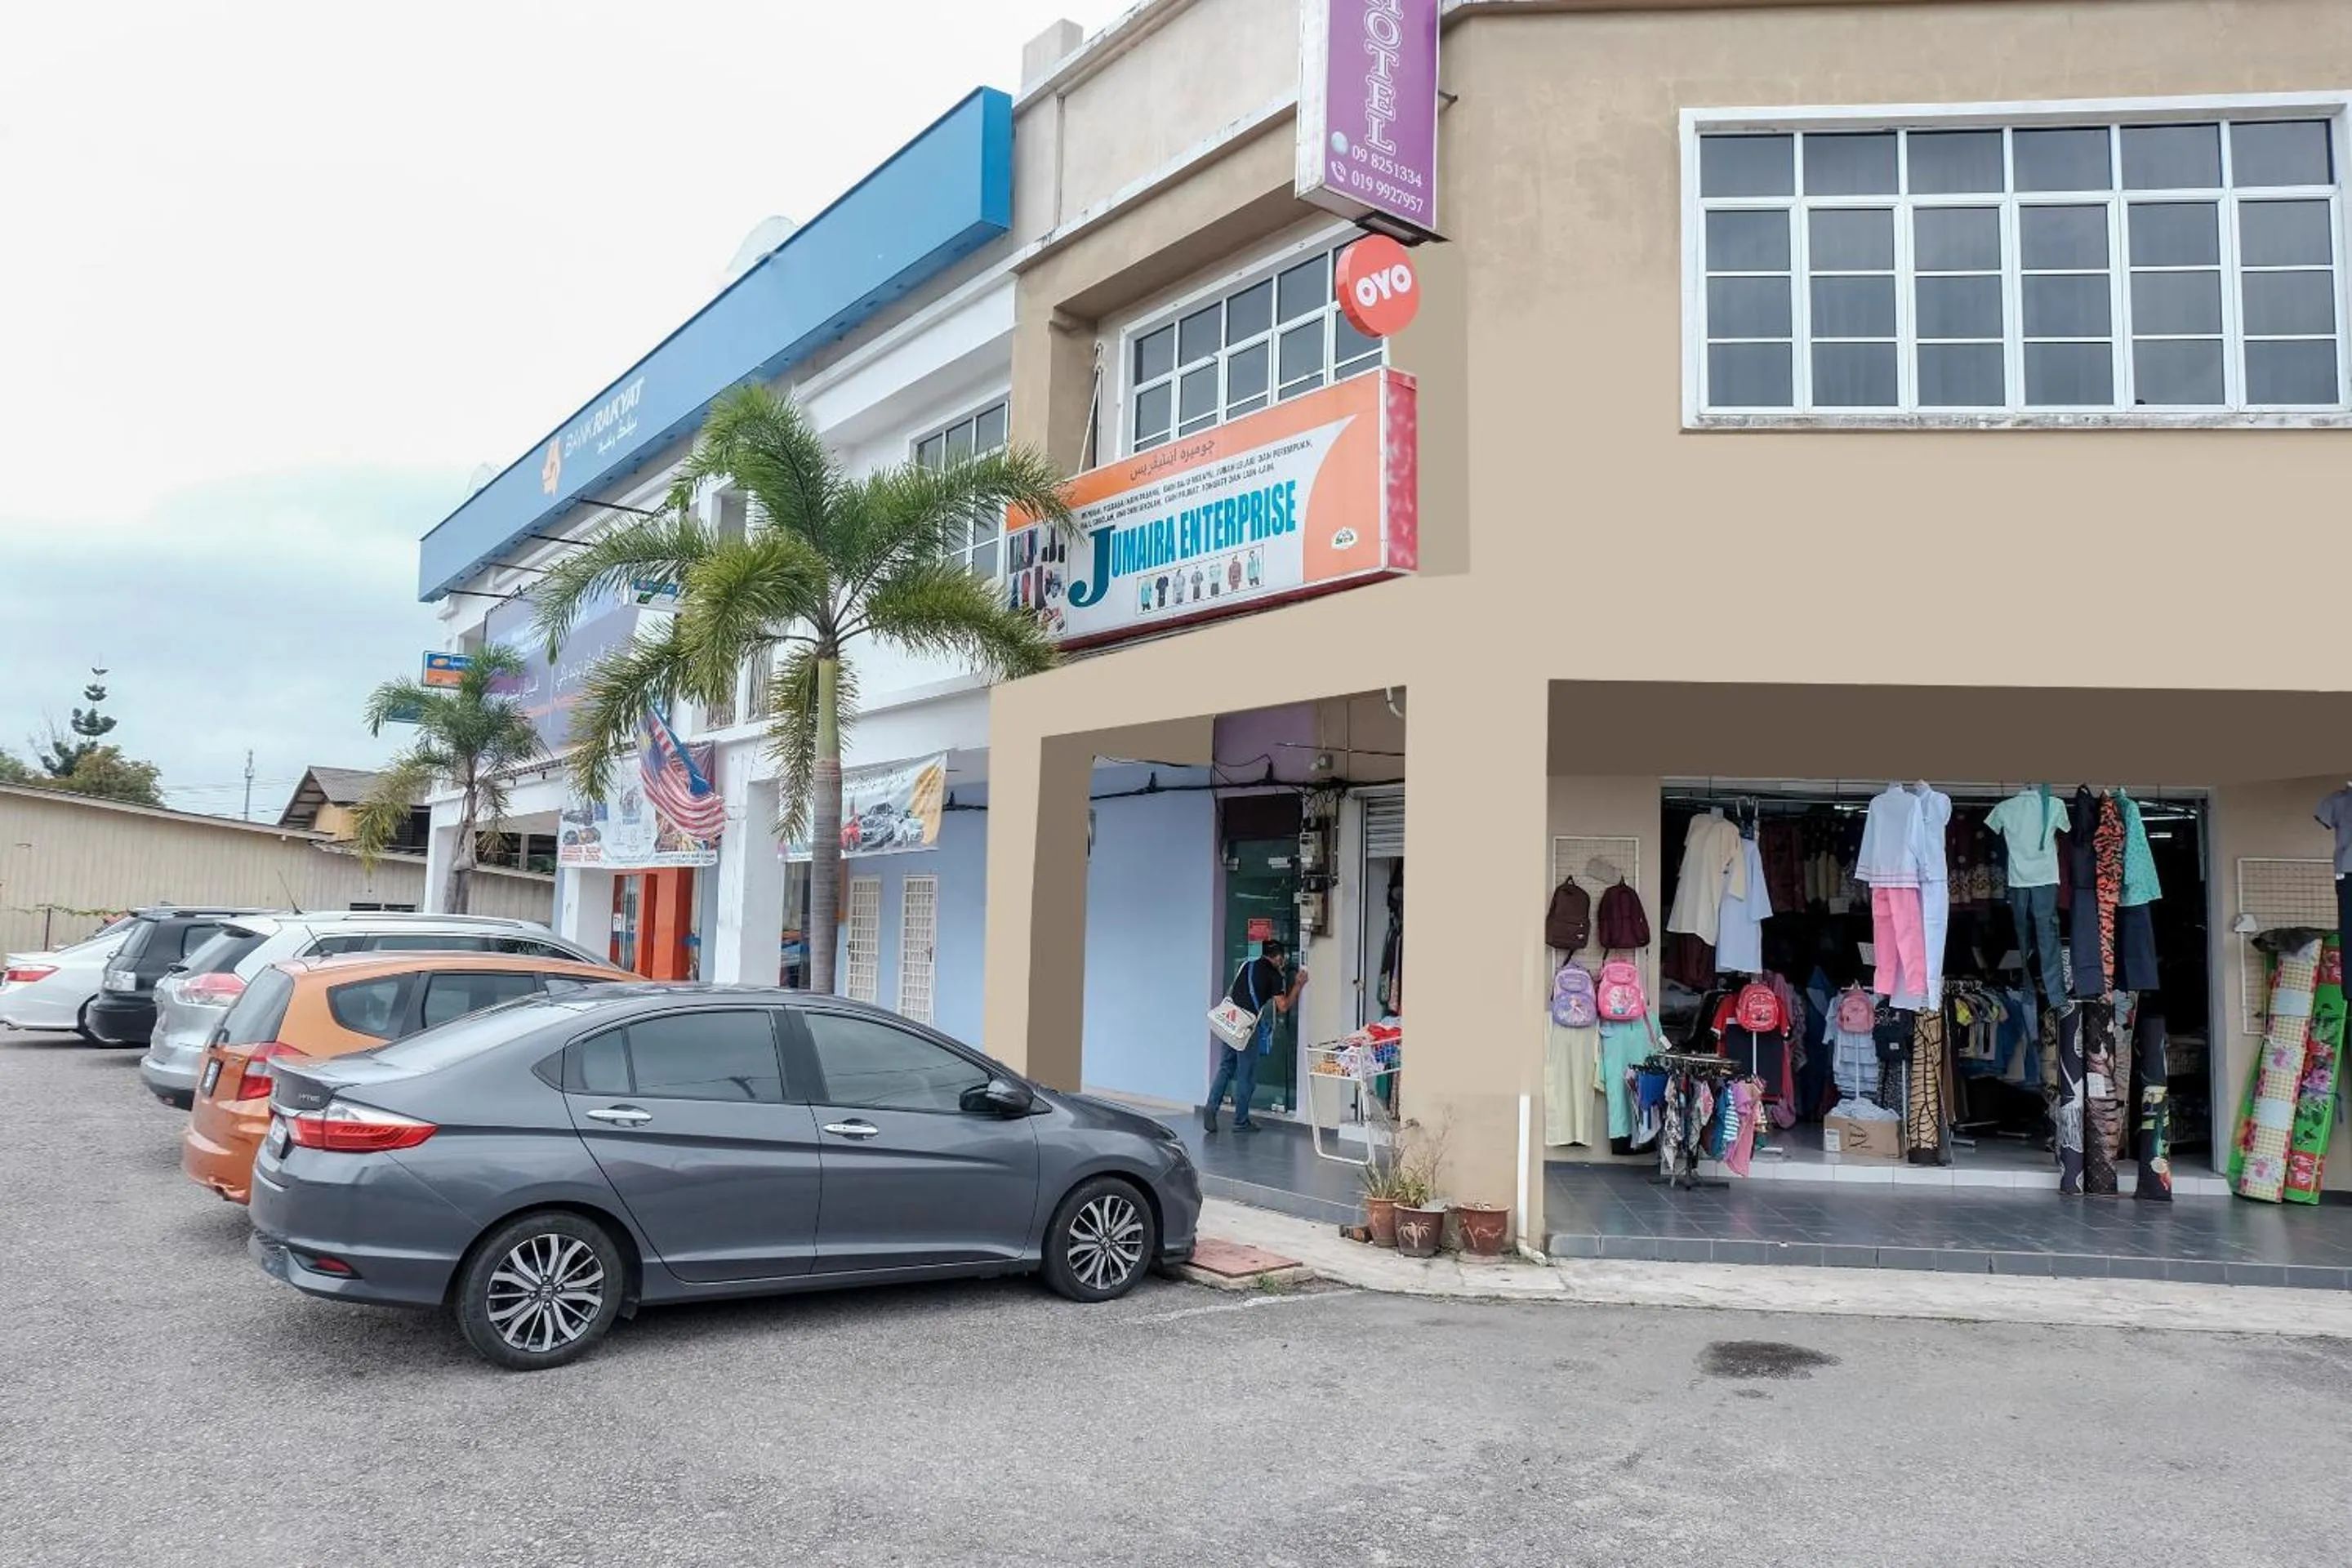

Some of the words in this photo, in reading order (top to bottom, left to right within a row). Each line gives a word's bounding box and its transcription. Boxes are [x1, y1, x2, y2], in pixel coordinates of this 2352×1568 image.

[1352, 145, 1367, 162] 09
[1371, 154, 1423, 188] 8251334
[1352, 170, 1373, 192] 019
[1376, 180, 1423, 214] 9927957
[1356, 264, 1412, 307] OYO
[1068, 514, 1176, 608] JUMAIRA
[1180, 479, 1296, 560] ENTERPRISE
